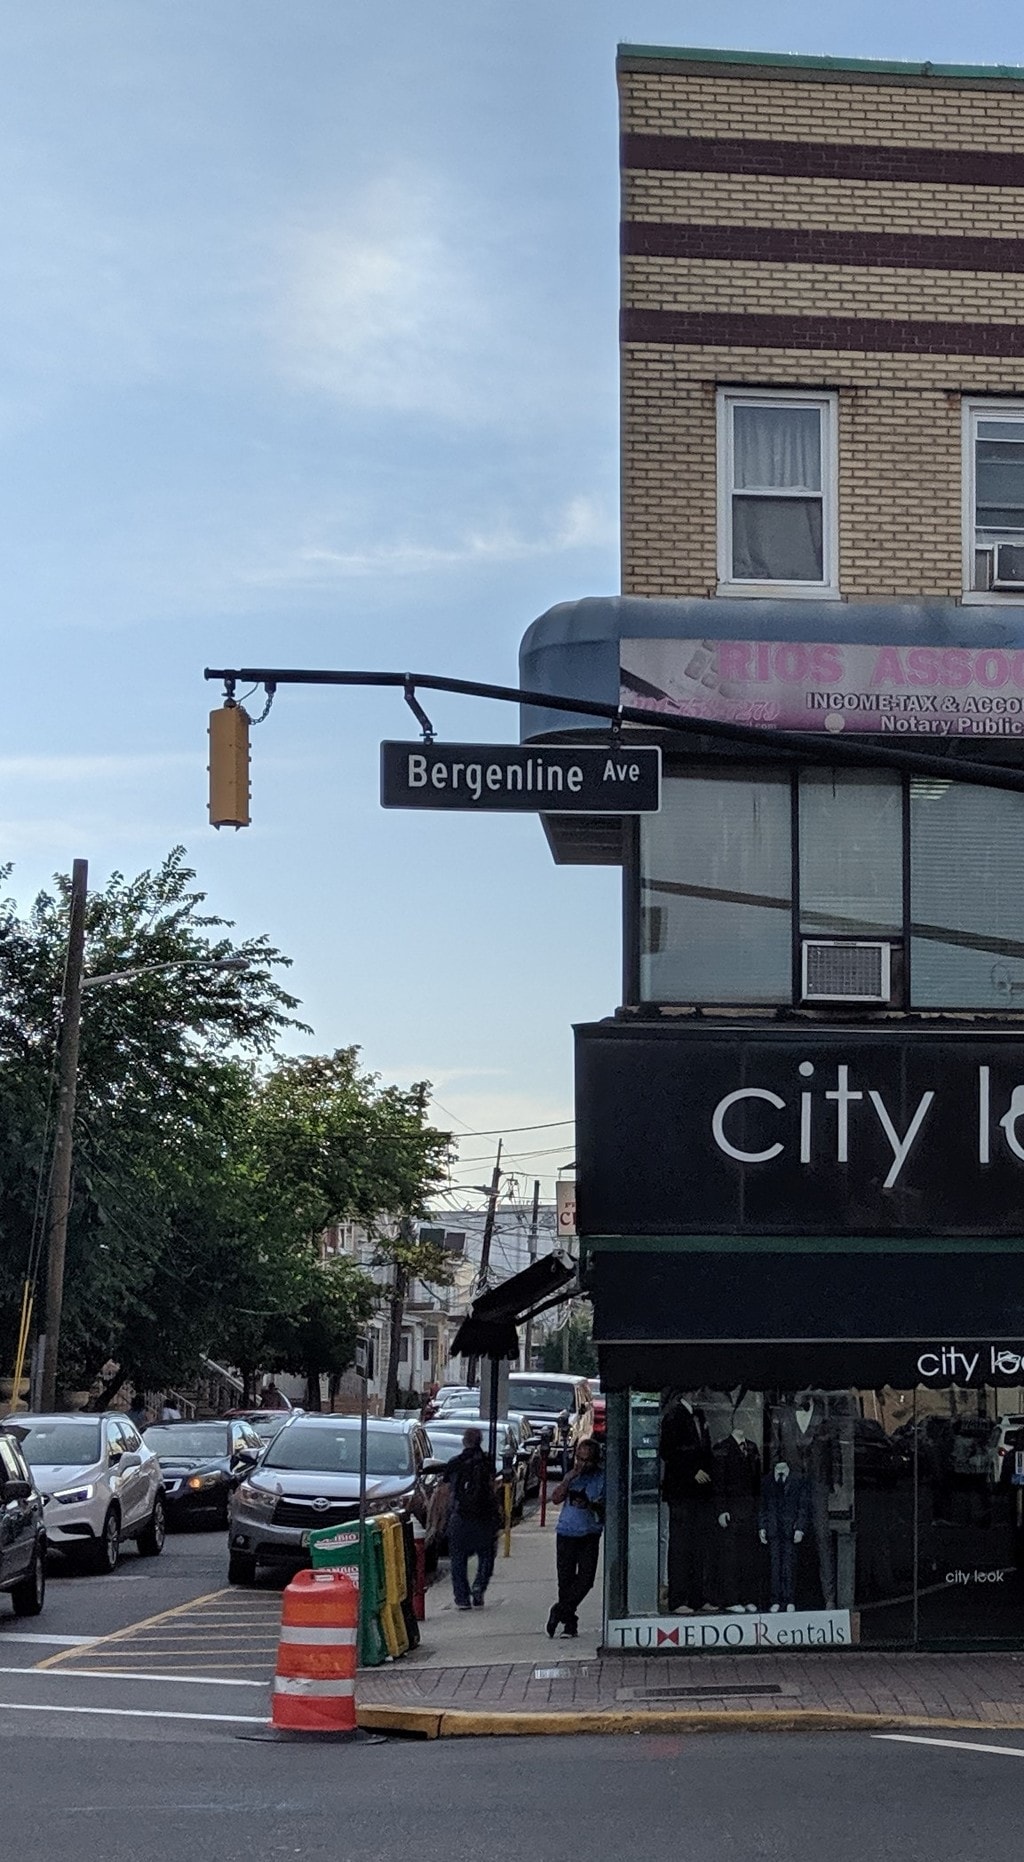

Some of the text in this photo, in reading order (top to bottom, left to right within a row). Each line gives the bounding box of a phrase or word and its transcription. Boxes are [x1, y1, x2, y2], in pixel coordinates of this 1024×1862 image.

[718, 643, 846, 684] RIOS
[942, 695, 960, 713] &
[881, 715, 1024, 735] Notary Public
[408, 754, 641, 800] Bergenline Ave
[711, 1061, 935, 1188] city
[917, 1346, 979, 1382] city
[945, 1569, 1004, 1585] city look
[755, 1619, 846, 1645] Rentals
